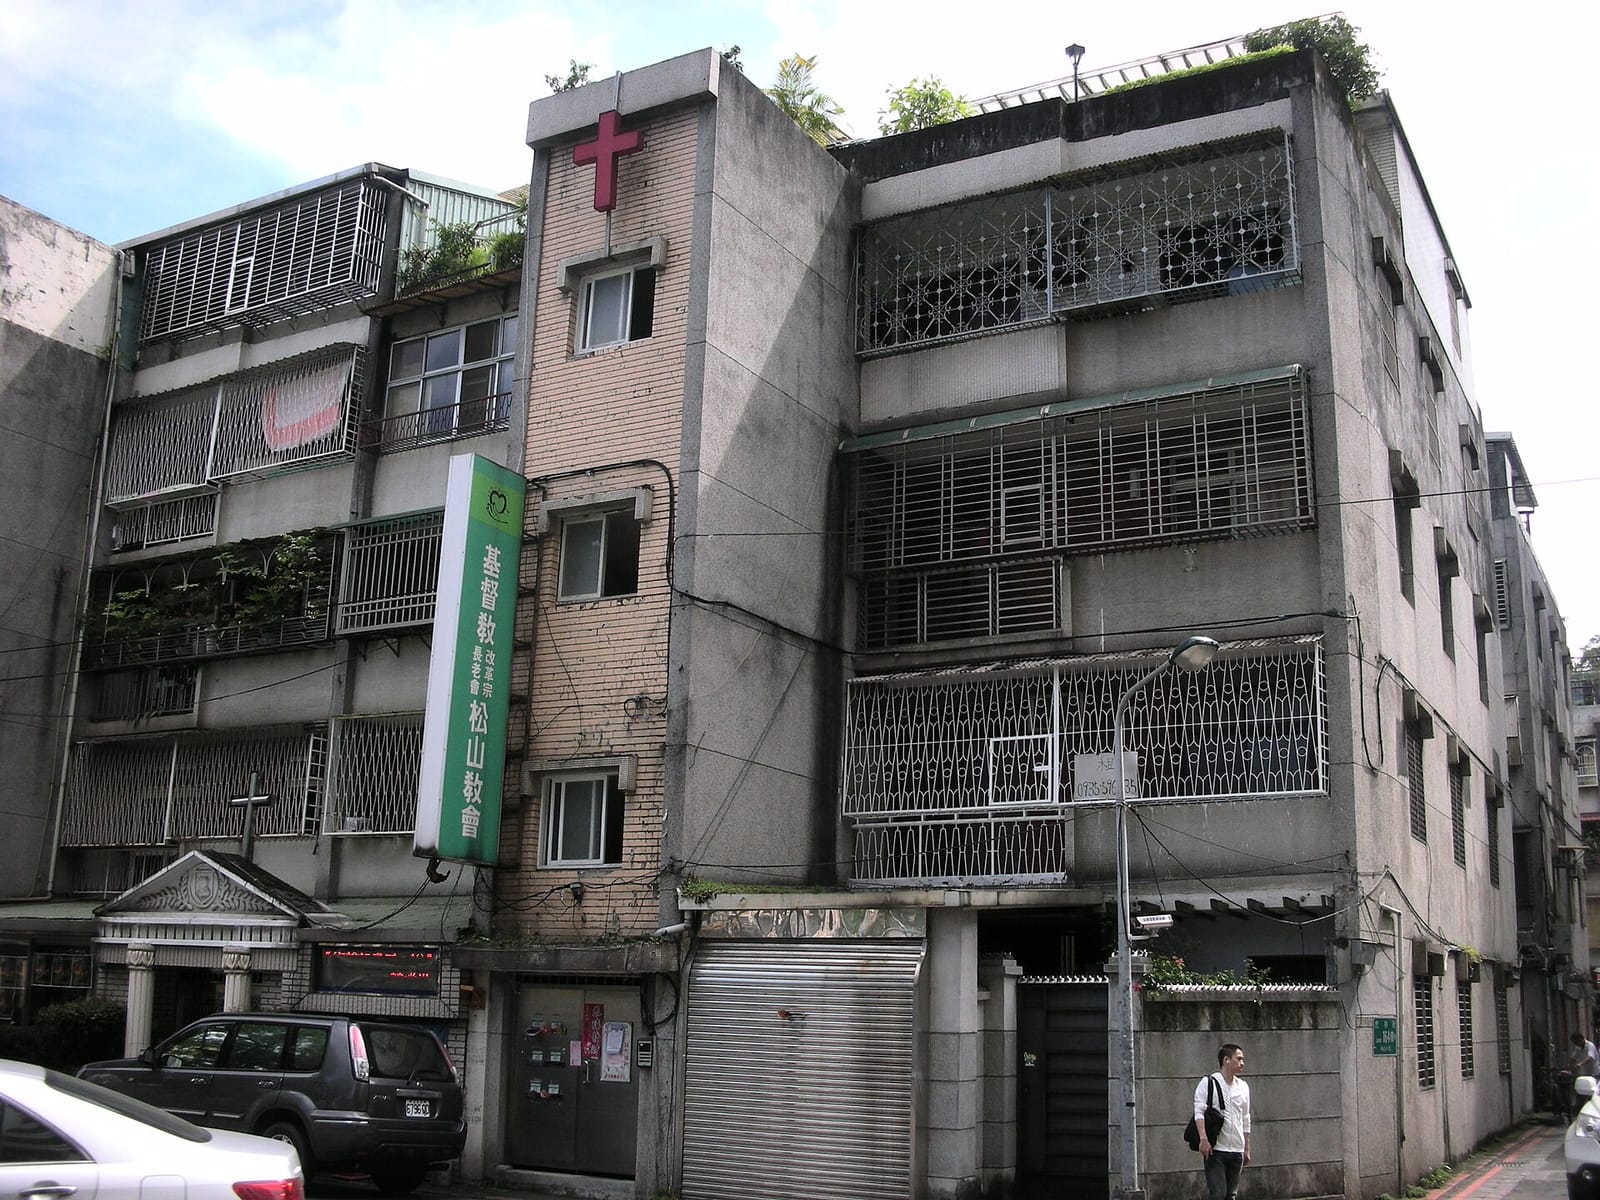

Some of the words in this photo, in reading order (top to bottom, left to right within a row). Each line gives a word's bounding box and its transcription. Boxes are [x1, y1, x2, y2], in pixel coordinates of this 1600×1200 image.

[476, 543, 501, 646] 基督教
[469, 645, 483, 696] 長老會
[482, 649, 496, 699] 改革宗
[461, 700, 489, 839] 松山教會
